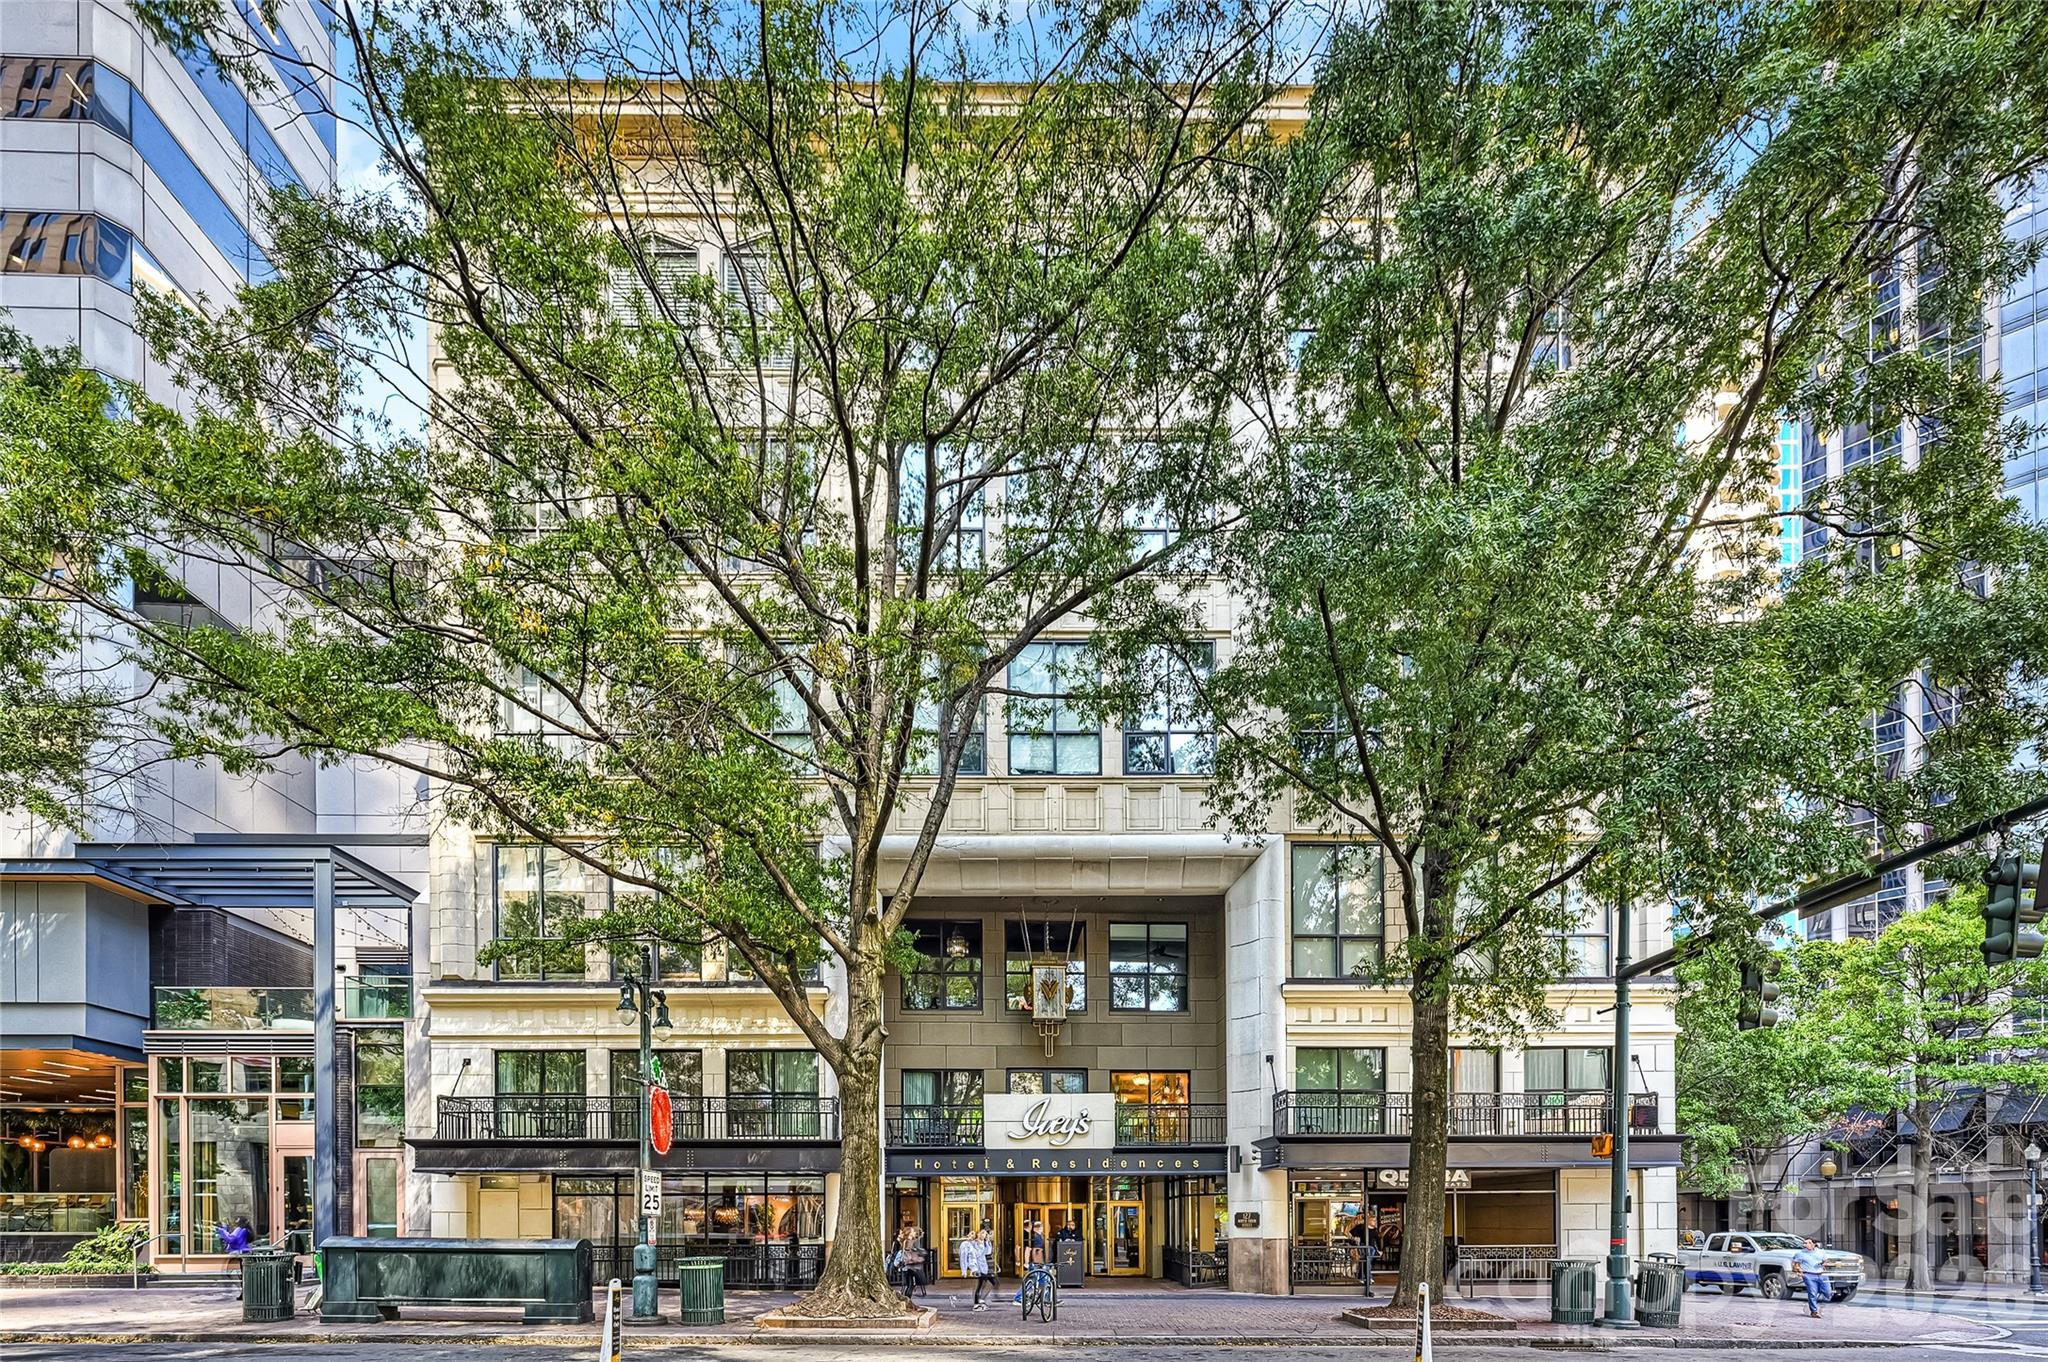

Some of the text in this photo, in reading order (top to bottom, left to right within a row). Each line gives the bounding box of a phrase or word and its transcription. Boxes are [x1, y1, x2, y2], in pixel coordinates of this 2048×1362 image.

[1007, 1097, 1093, 1147] Ivey's
[914, 1157, 1200, 1169] Hotel & Residences
[644, 1174, 660, 1184] SPEED
[644, 1184, 658, 1193] LIMIT
[644, 1193, 660, 1210] 25
